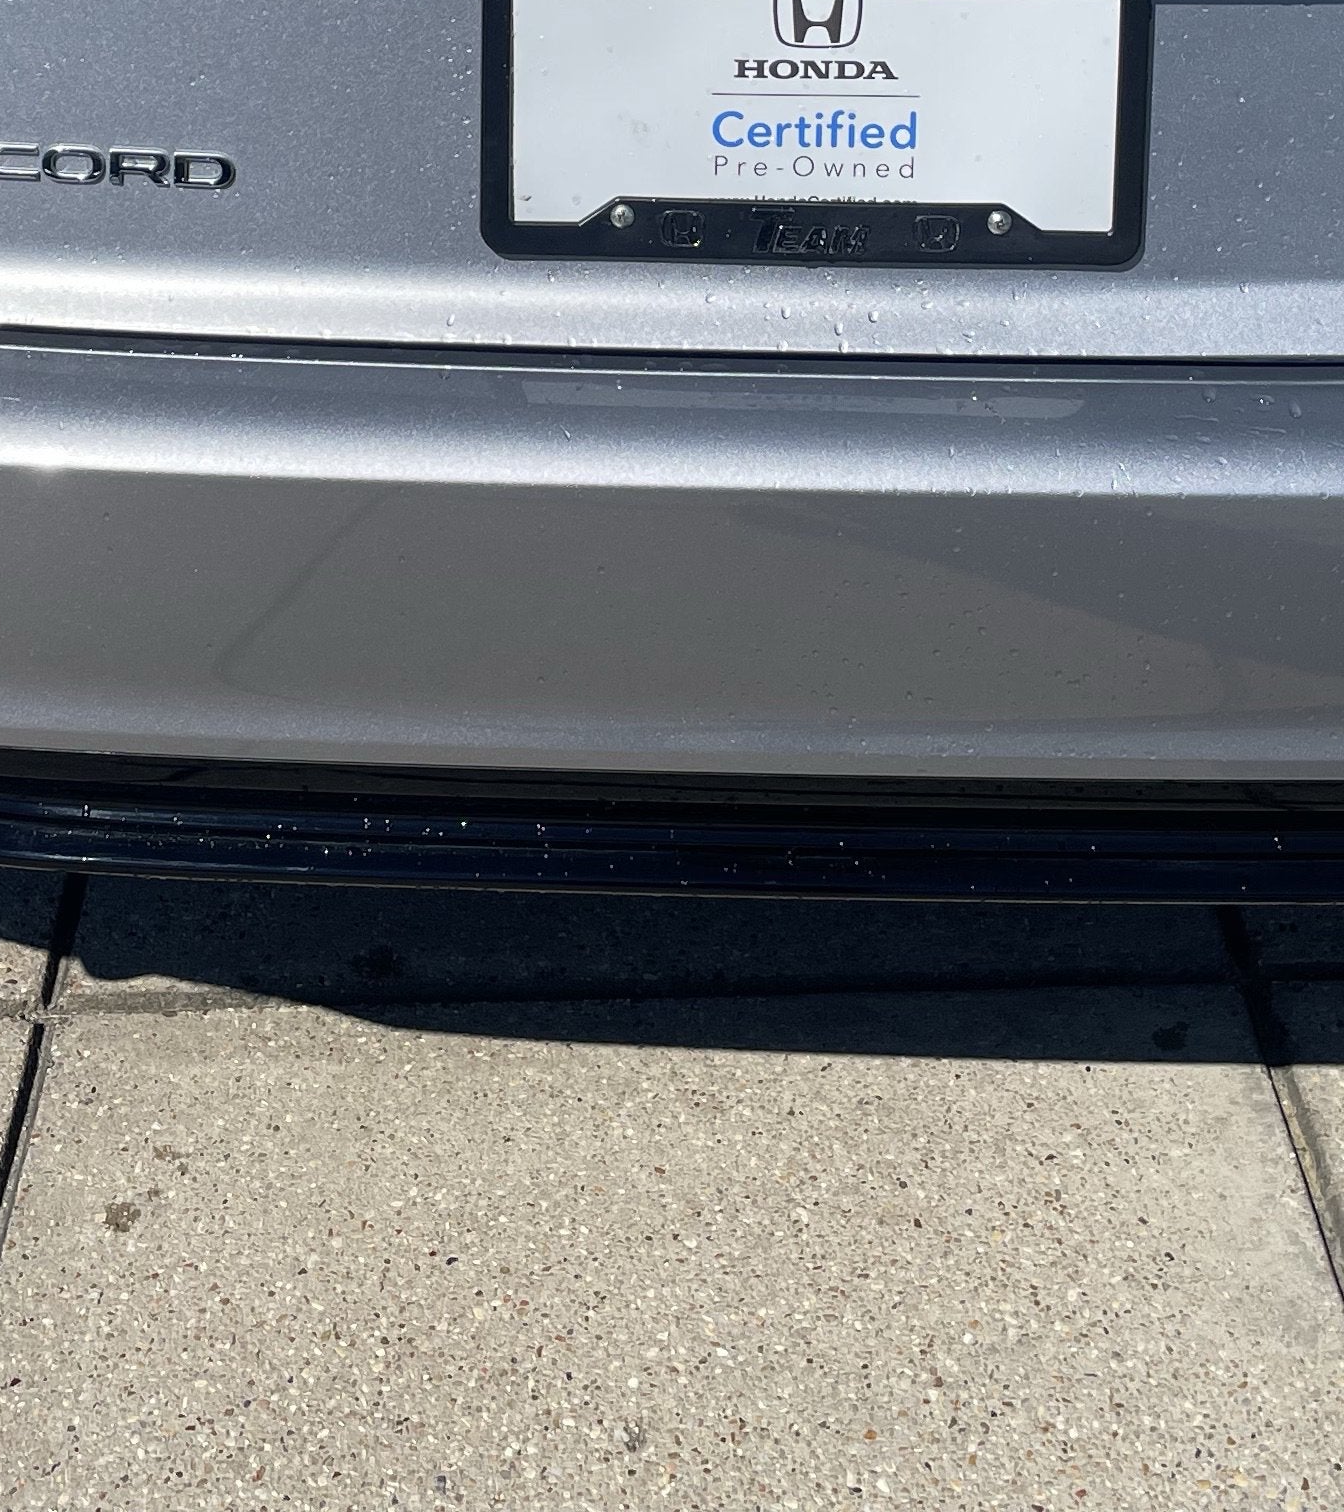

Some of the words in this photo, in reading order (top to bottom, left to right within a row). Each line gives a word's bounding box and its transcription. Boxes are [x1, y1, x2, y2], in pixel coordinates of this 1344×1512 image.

[733, 59, 899, 80] HONDA
[712, 109, 918, 150] Certified
[714, 155, 915, 179] Pre-Owned
